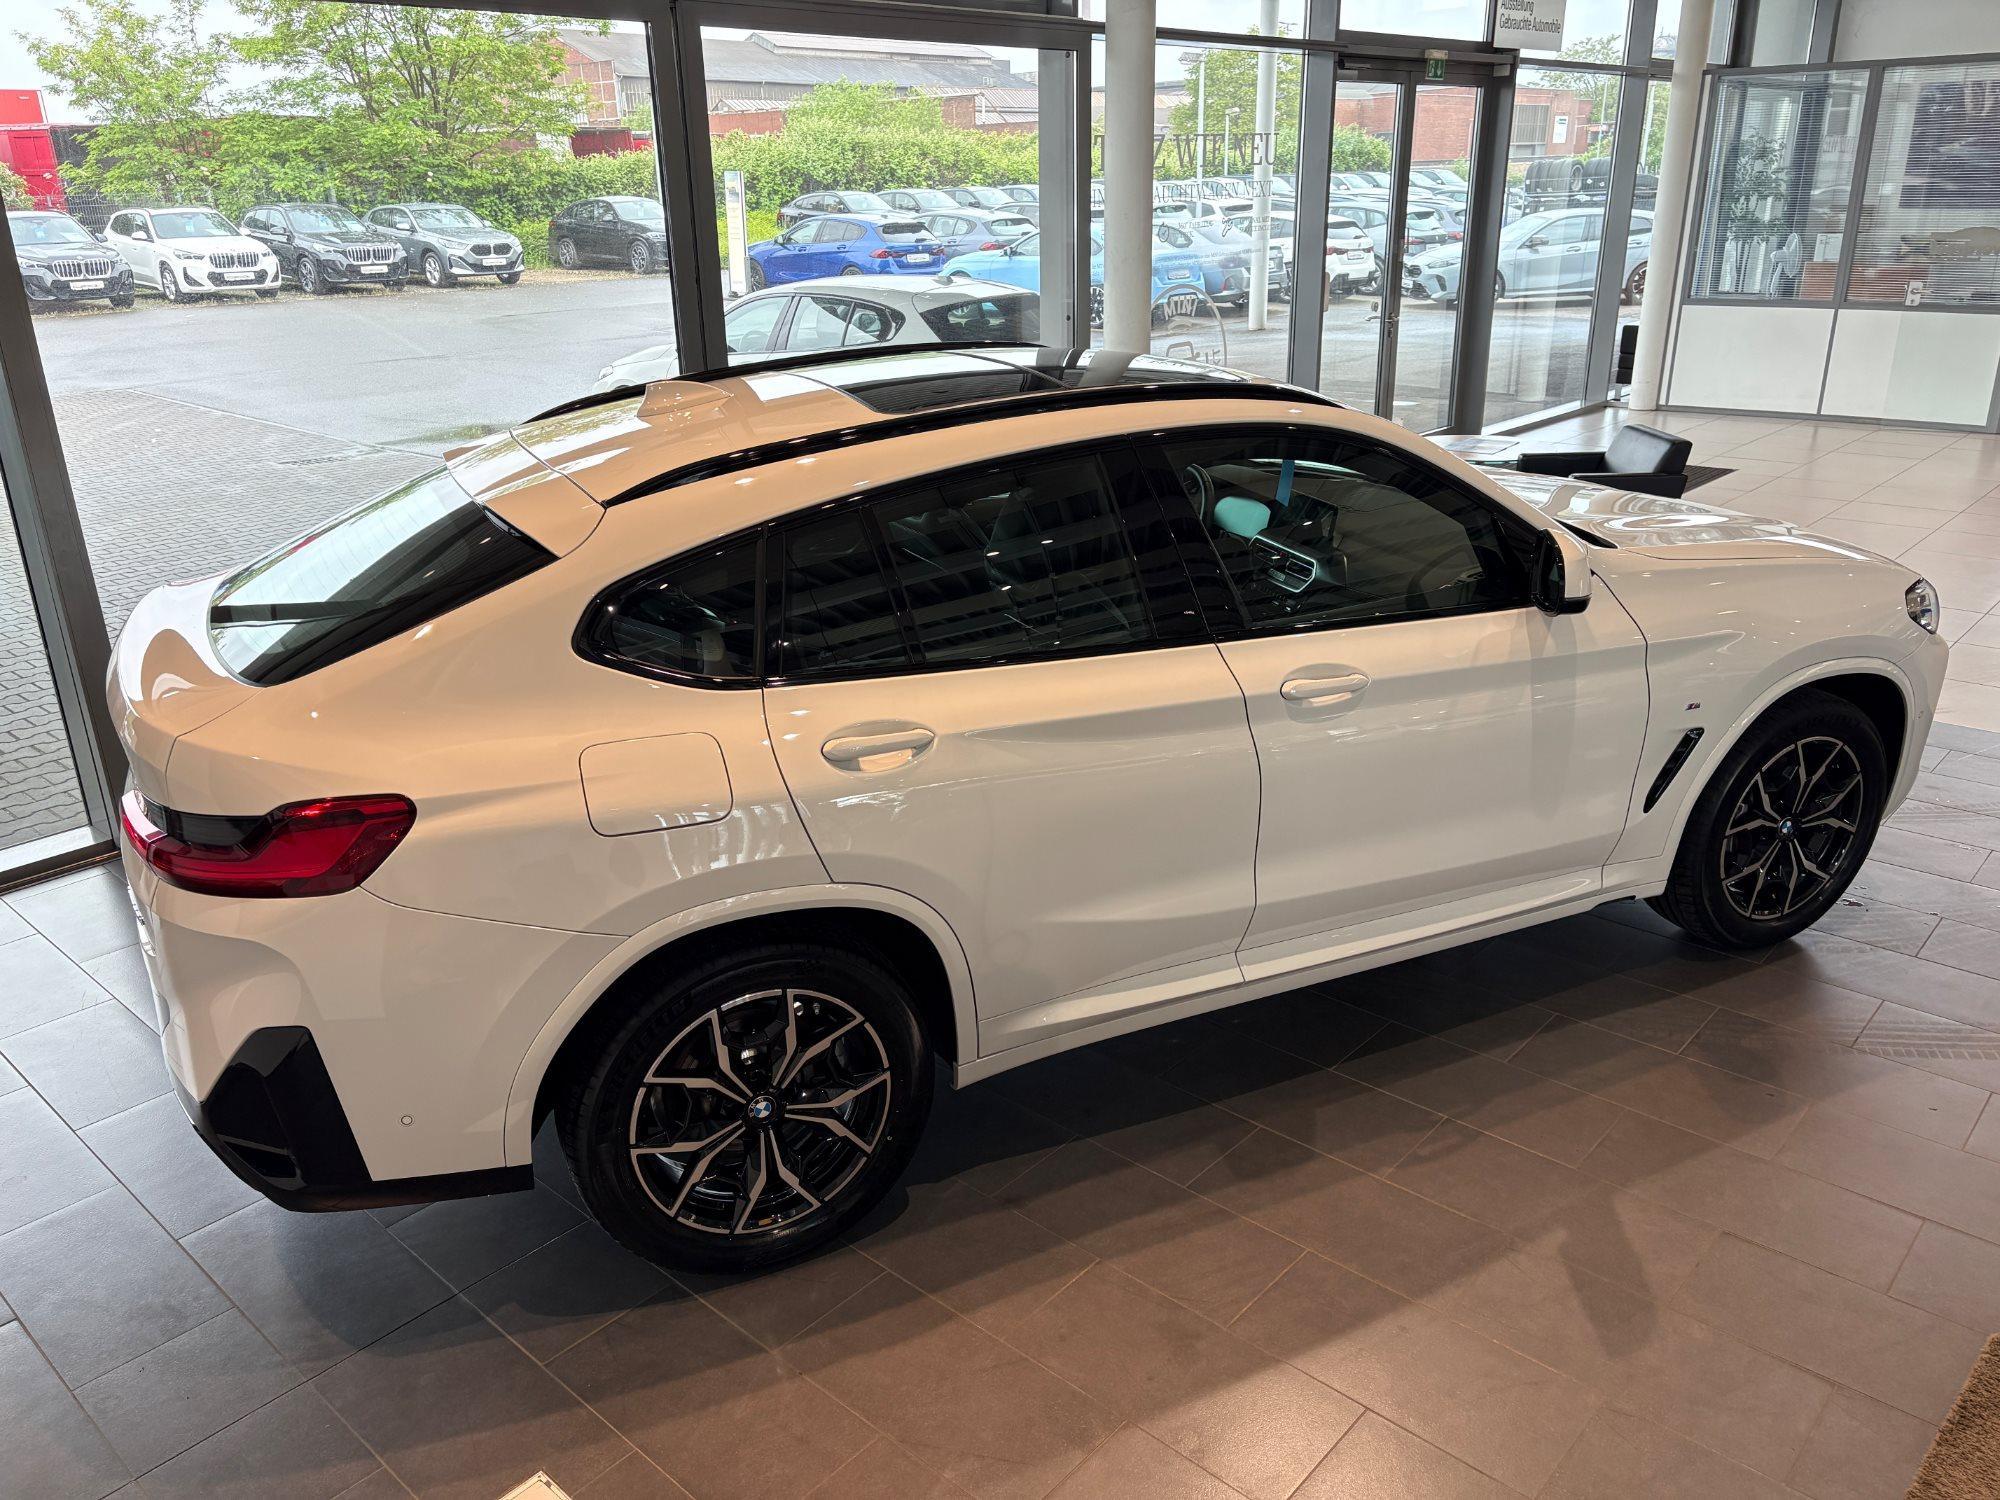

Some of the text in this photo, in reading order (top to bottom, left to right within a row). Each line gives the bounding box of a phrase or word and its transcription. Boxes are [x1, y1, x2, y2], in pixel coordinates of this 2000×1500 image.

[1500, 0, 1534, 15] Ausstellung
[1500, 13, 1561, 33] Gebrauchte Automobile
[1173, 133, 1225, 169] WIE
[1230, 133, 1280, 167] NEU
[1163, 294, 1199, 320] MINI
